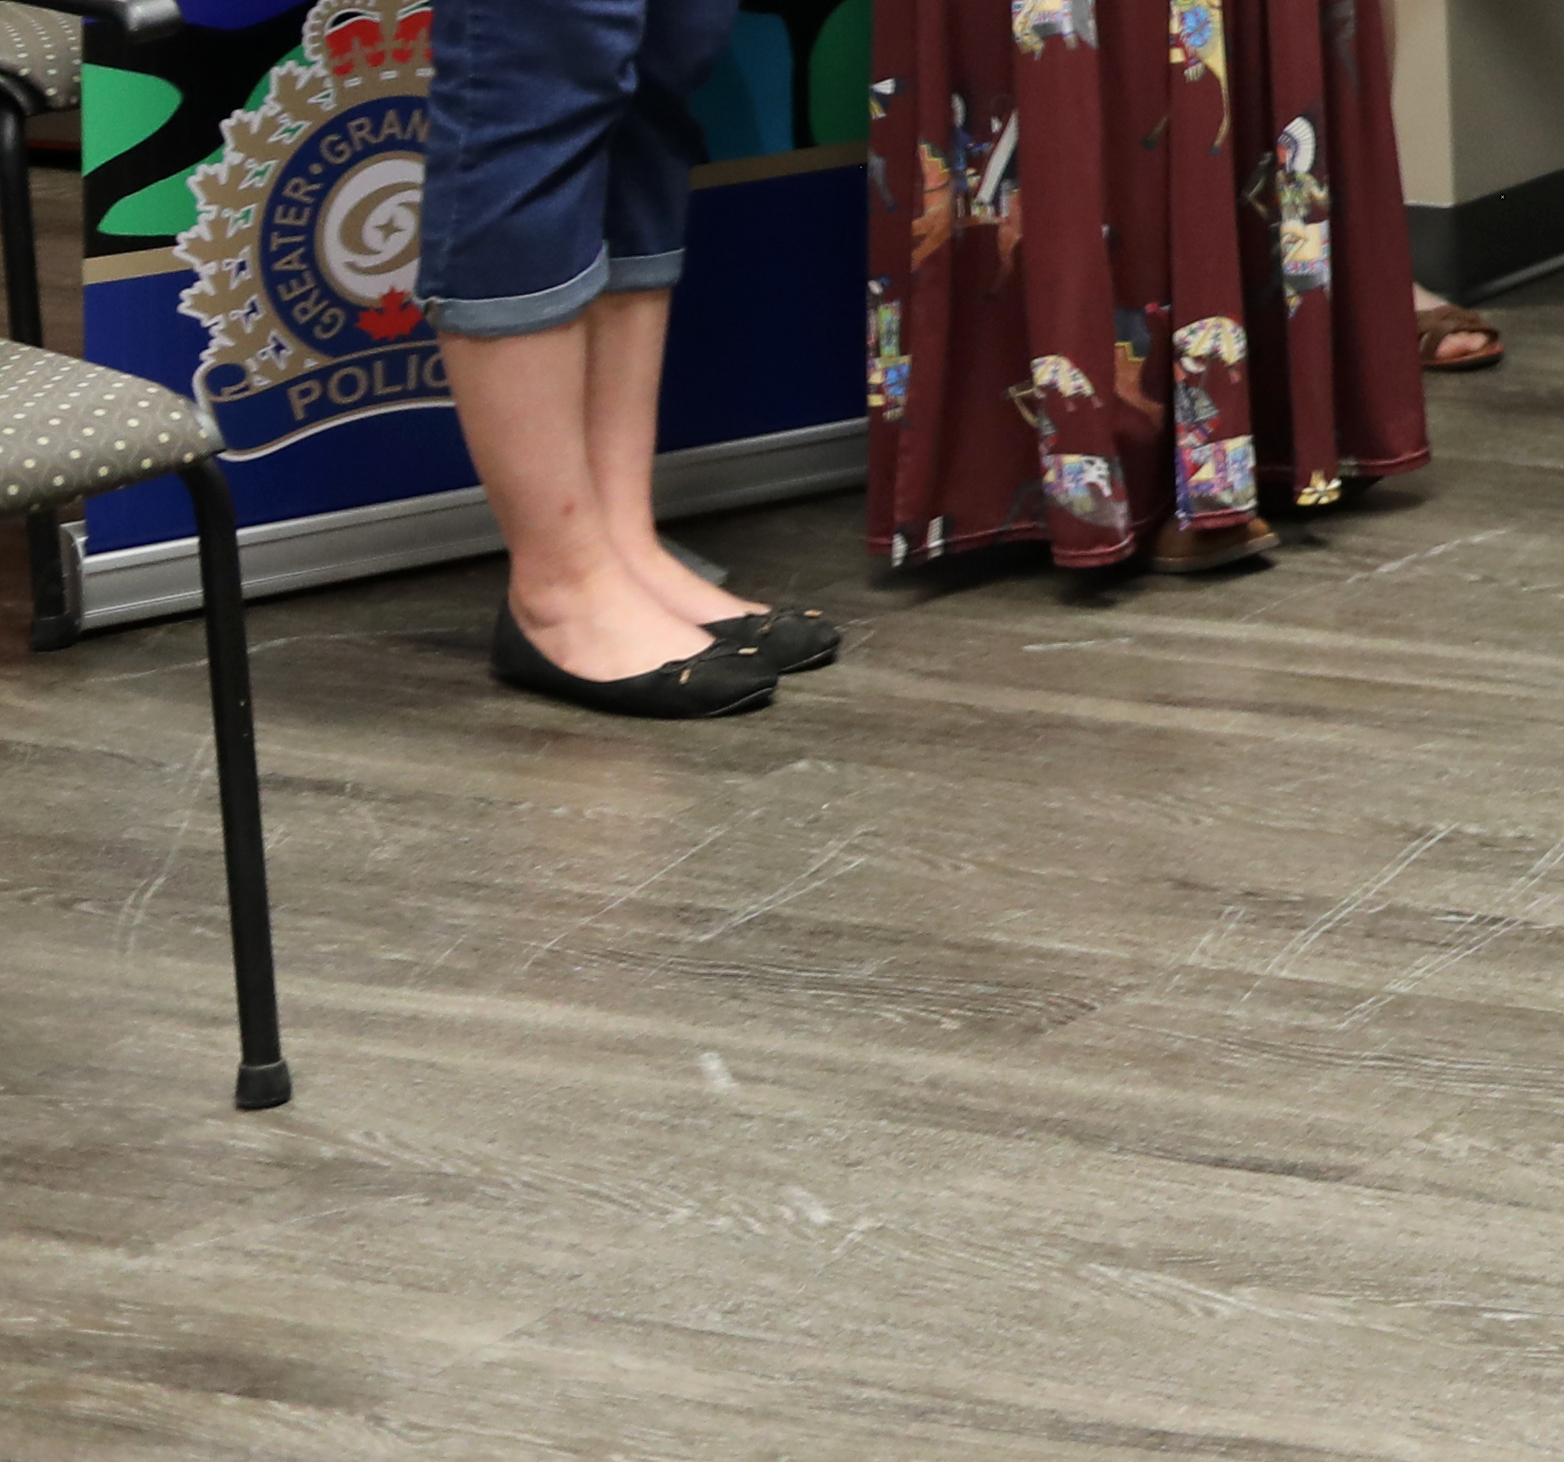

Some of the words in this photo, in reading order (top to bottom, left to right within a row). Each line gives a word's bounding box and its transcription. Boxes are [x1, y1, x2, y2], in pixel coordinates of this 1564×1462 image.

[273, 176, 345, 339] GREATER
[320, 109, 430, 163] GRAN
[285, 352, 451, 423] POLIC
